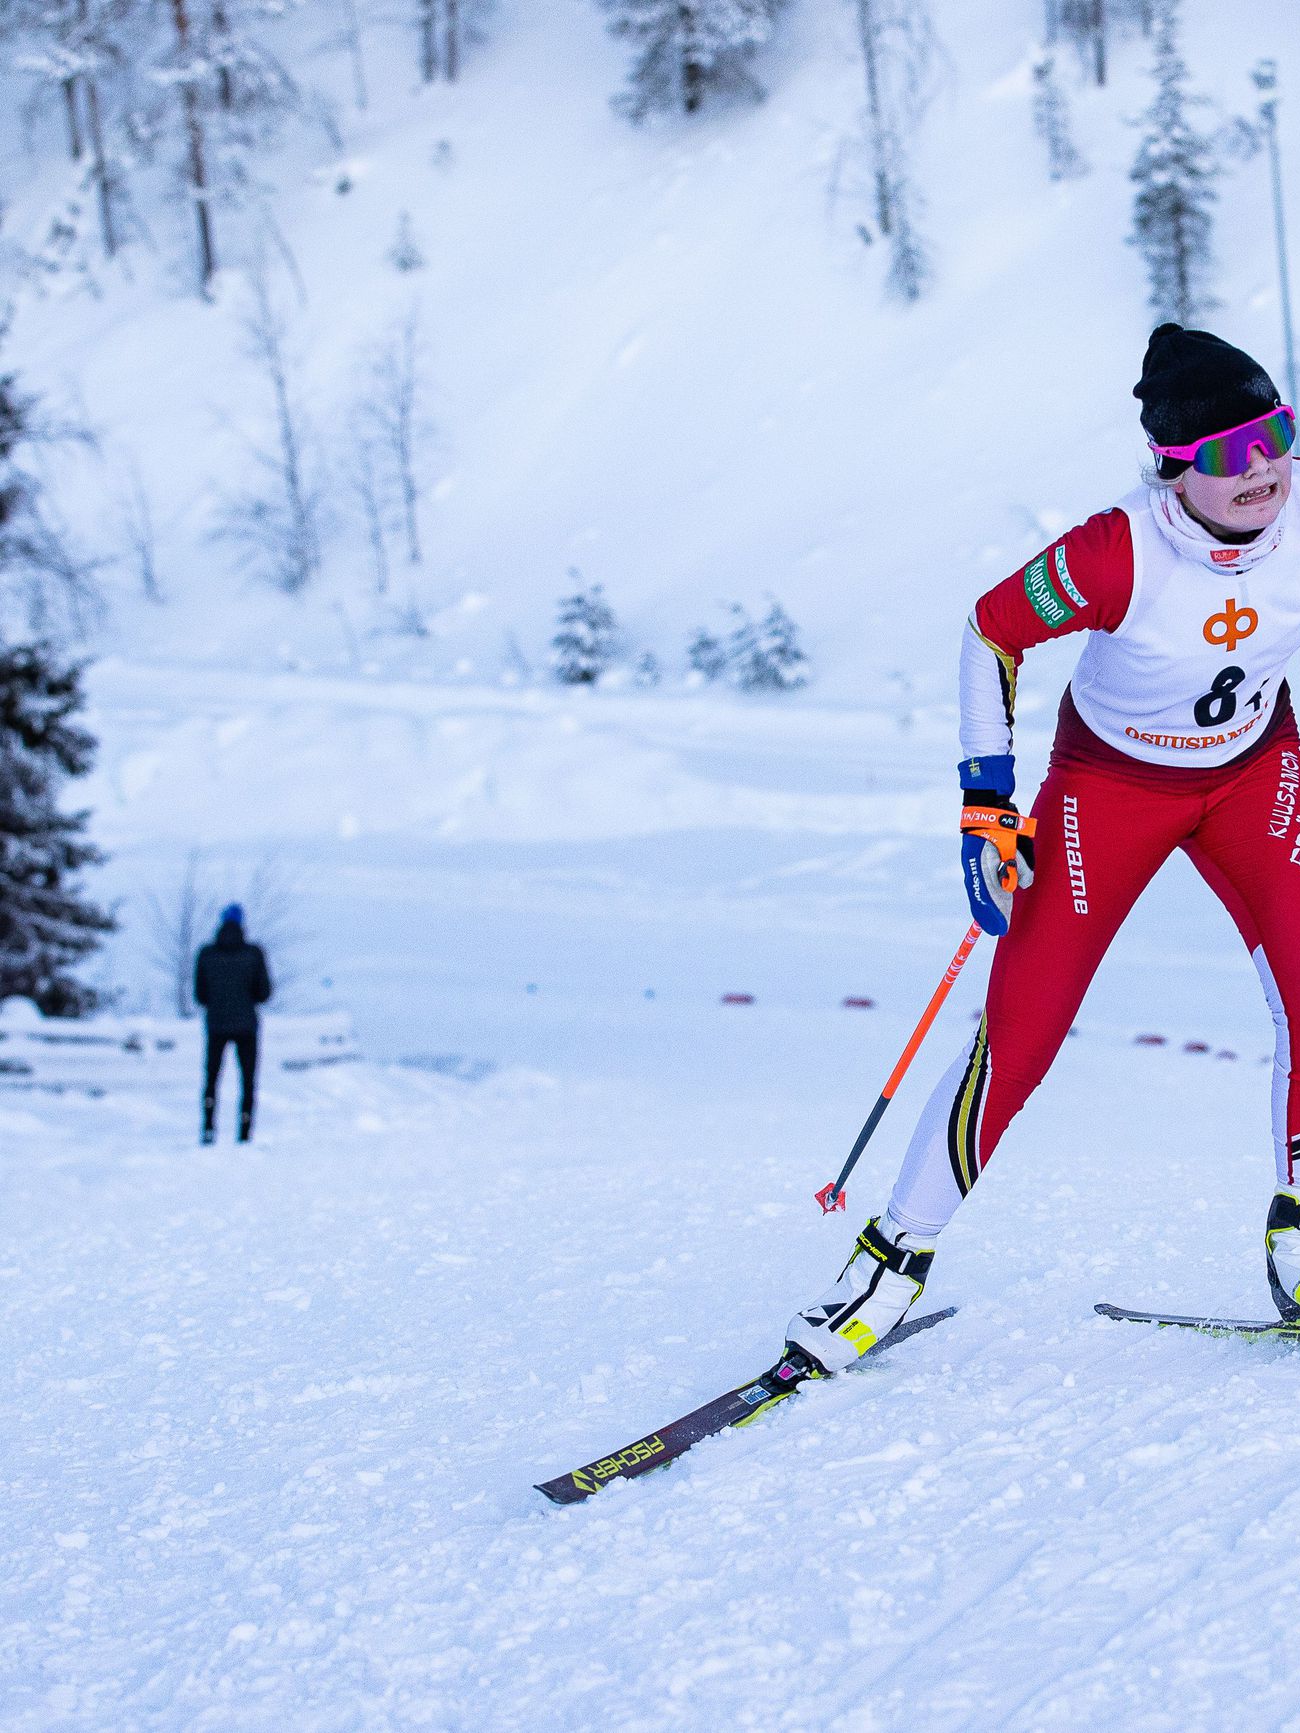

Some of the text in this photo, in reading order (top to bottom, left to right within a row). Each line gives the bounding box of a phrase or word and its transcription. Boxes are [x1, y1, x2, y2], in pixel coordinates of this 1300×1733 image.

[1029, 558, 1065, 621] KUUSAMO
[1056, 547, 1085, 604] POLKKY
[1063, 794, 1088, 914] noname
[587, 1435, 666, 1479] FISCHER
